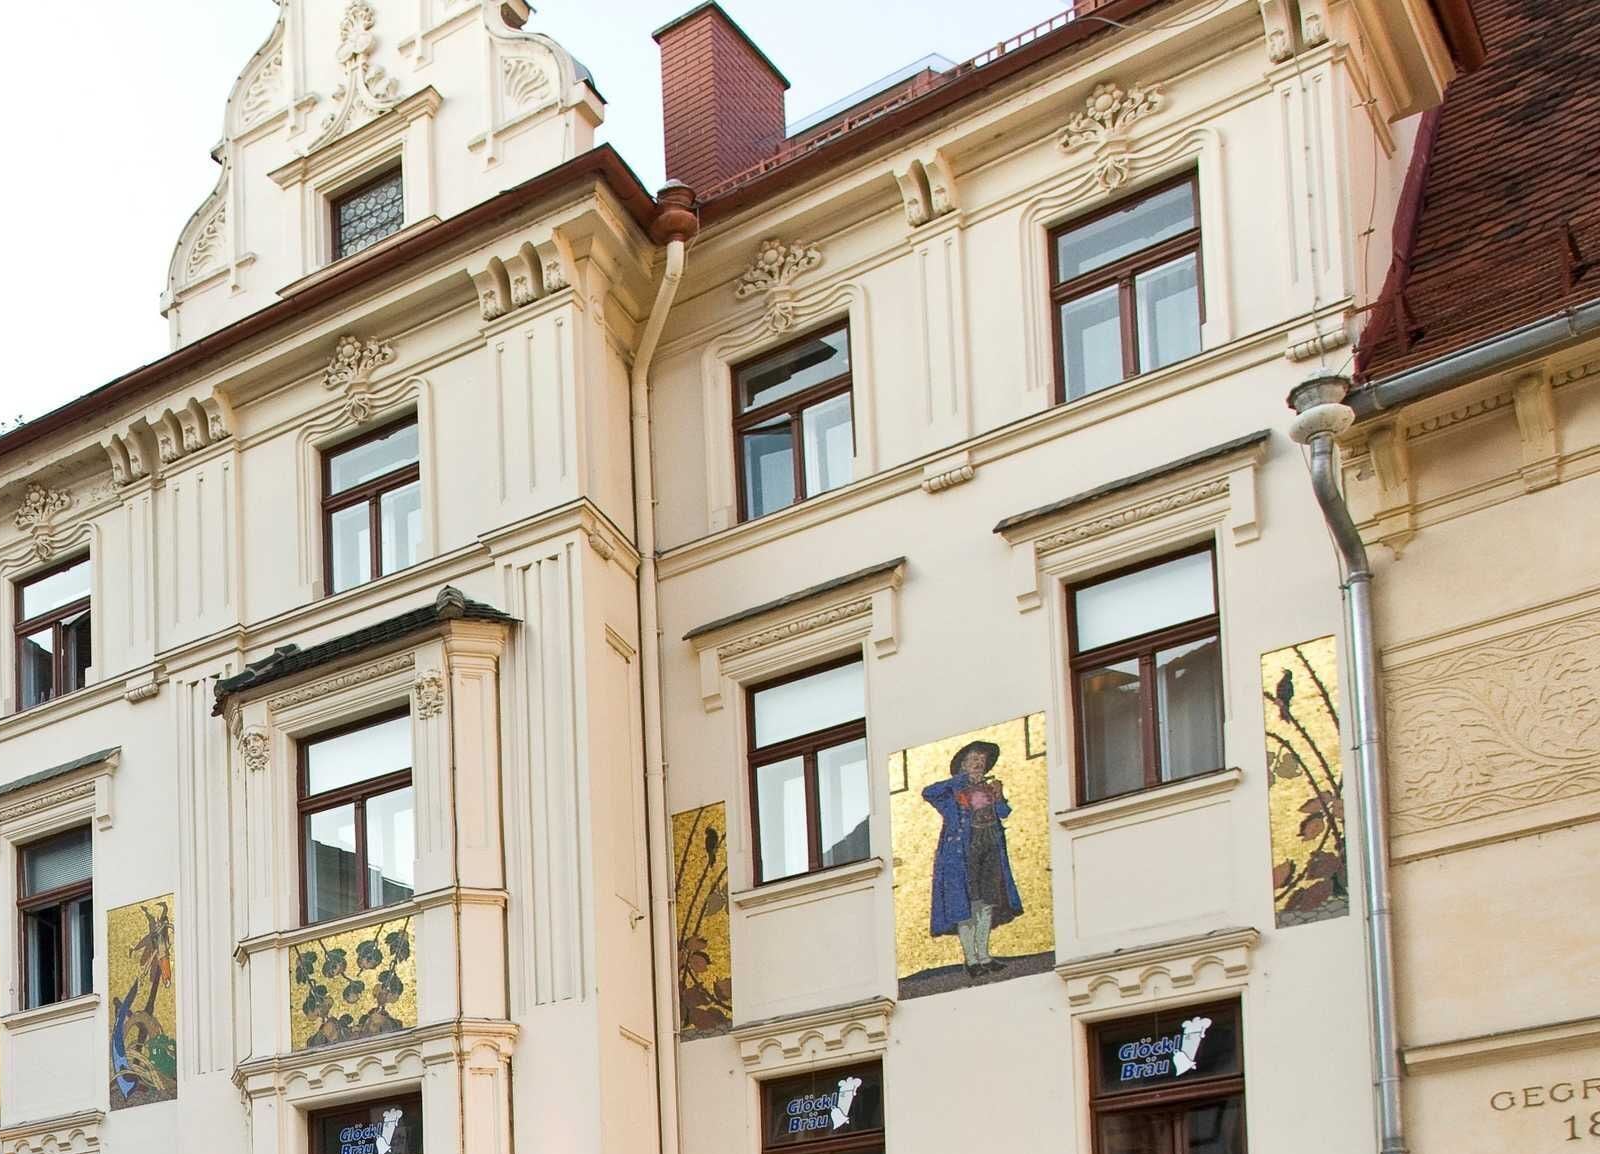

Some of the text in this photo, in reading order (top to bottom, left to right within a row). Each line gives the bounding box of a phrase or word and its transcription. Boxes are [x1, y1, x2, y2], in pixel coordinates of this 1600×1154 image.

[1119, 1033, 1181, 1061] Glöckl
[1120, 1056, 1170, 1081] Bräu
[787, 1092, 837, 1116] Glöckl
[340, 1122, 382, 1143] Glöckl
[789, 1111, 828, 1134] Bräu
